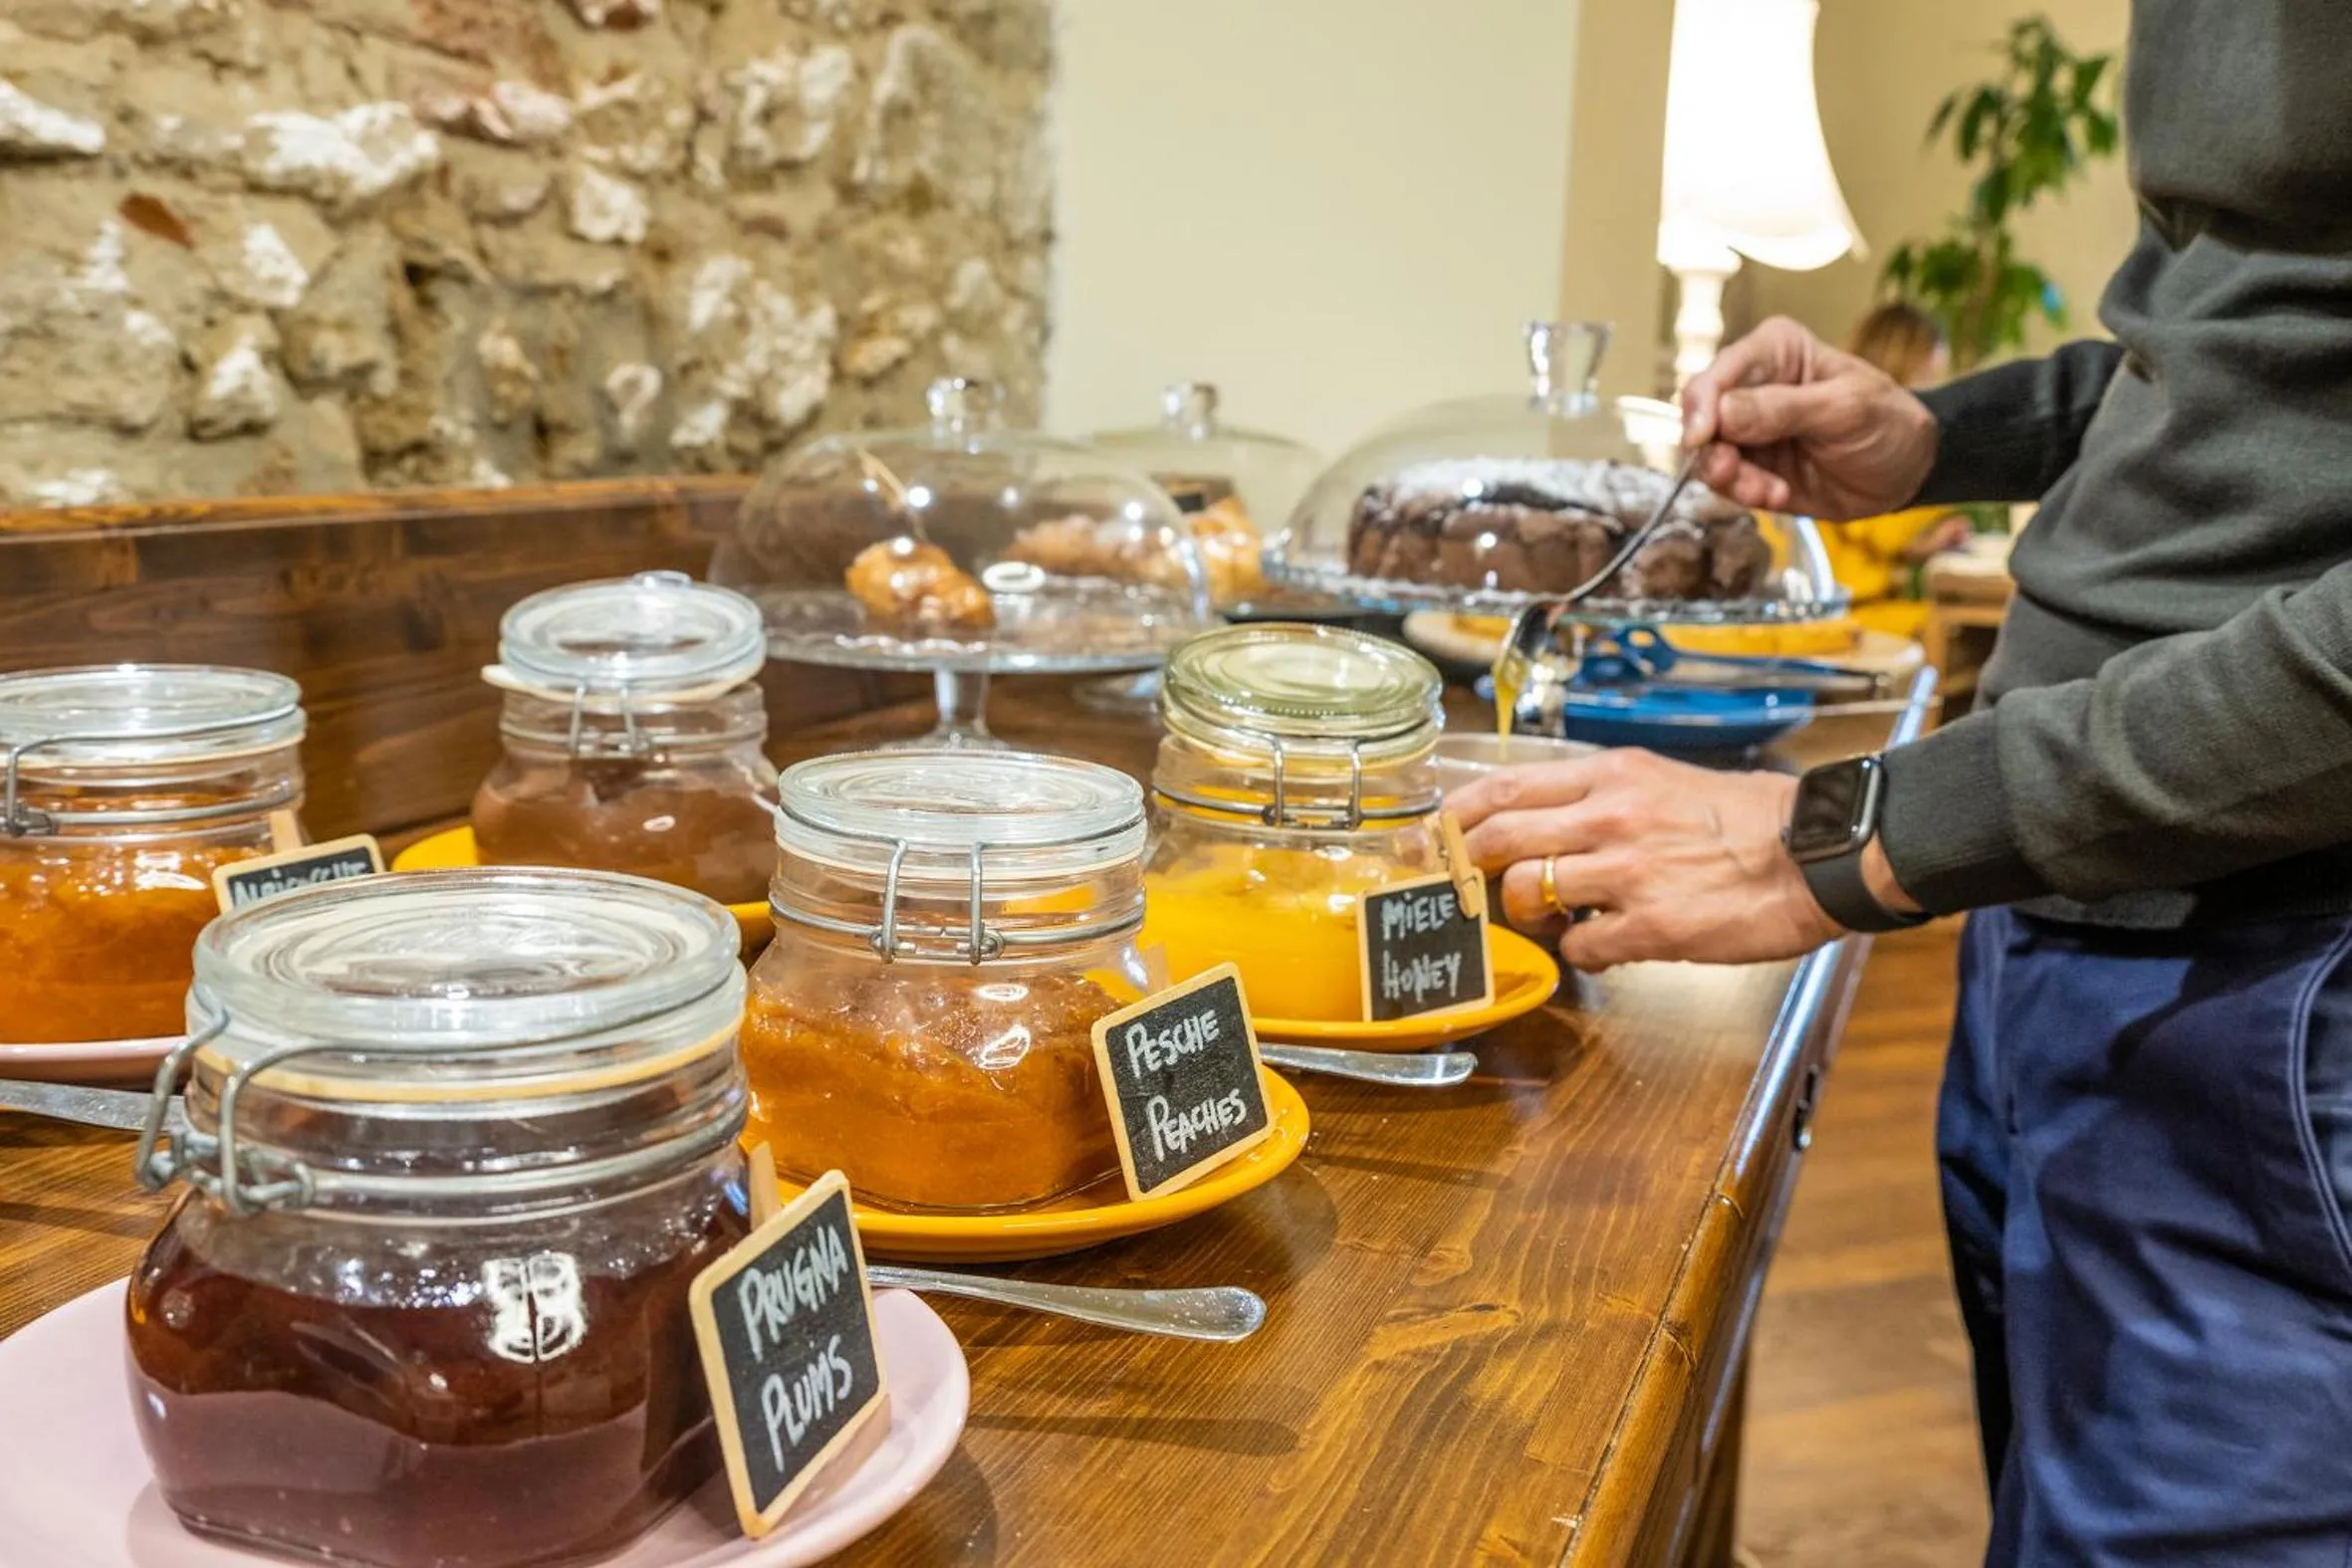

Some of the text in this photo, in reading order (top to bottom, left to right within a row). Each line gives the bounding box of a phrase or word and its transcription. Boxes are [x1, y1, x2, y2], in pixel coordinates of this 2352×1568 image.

[1382, 950, 1461, 1005] HONEY
[1124, 1008, 1220, 1080] PESCHE
[1147, 1087, 1247, 1163] PEACHES
[738, 1224, 848, 1364] PRUGNA
[761, 1334, 853, 1474] PLUMS
